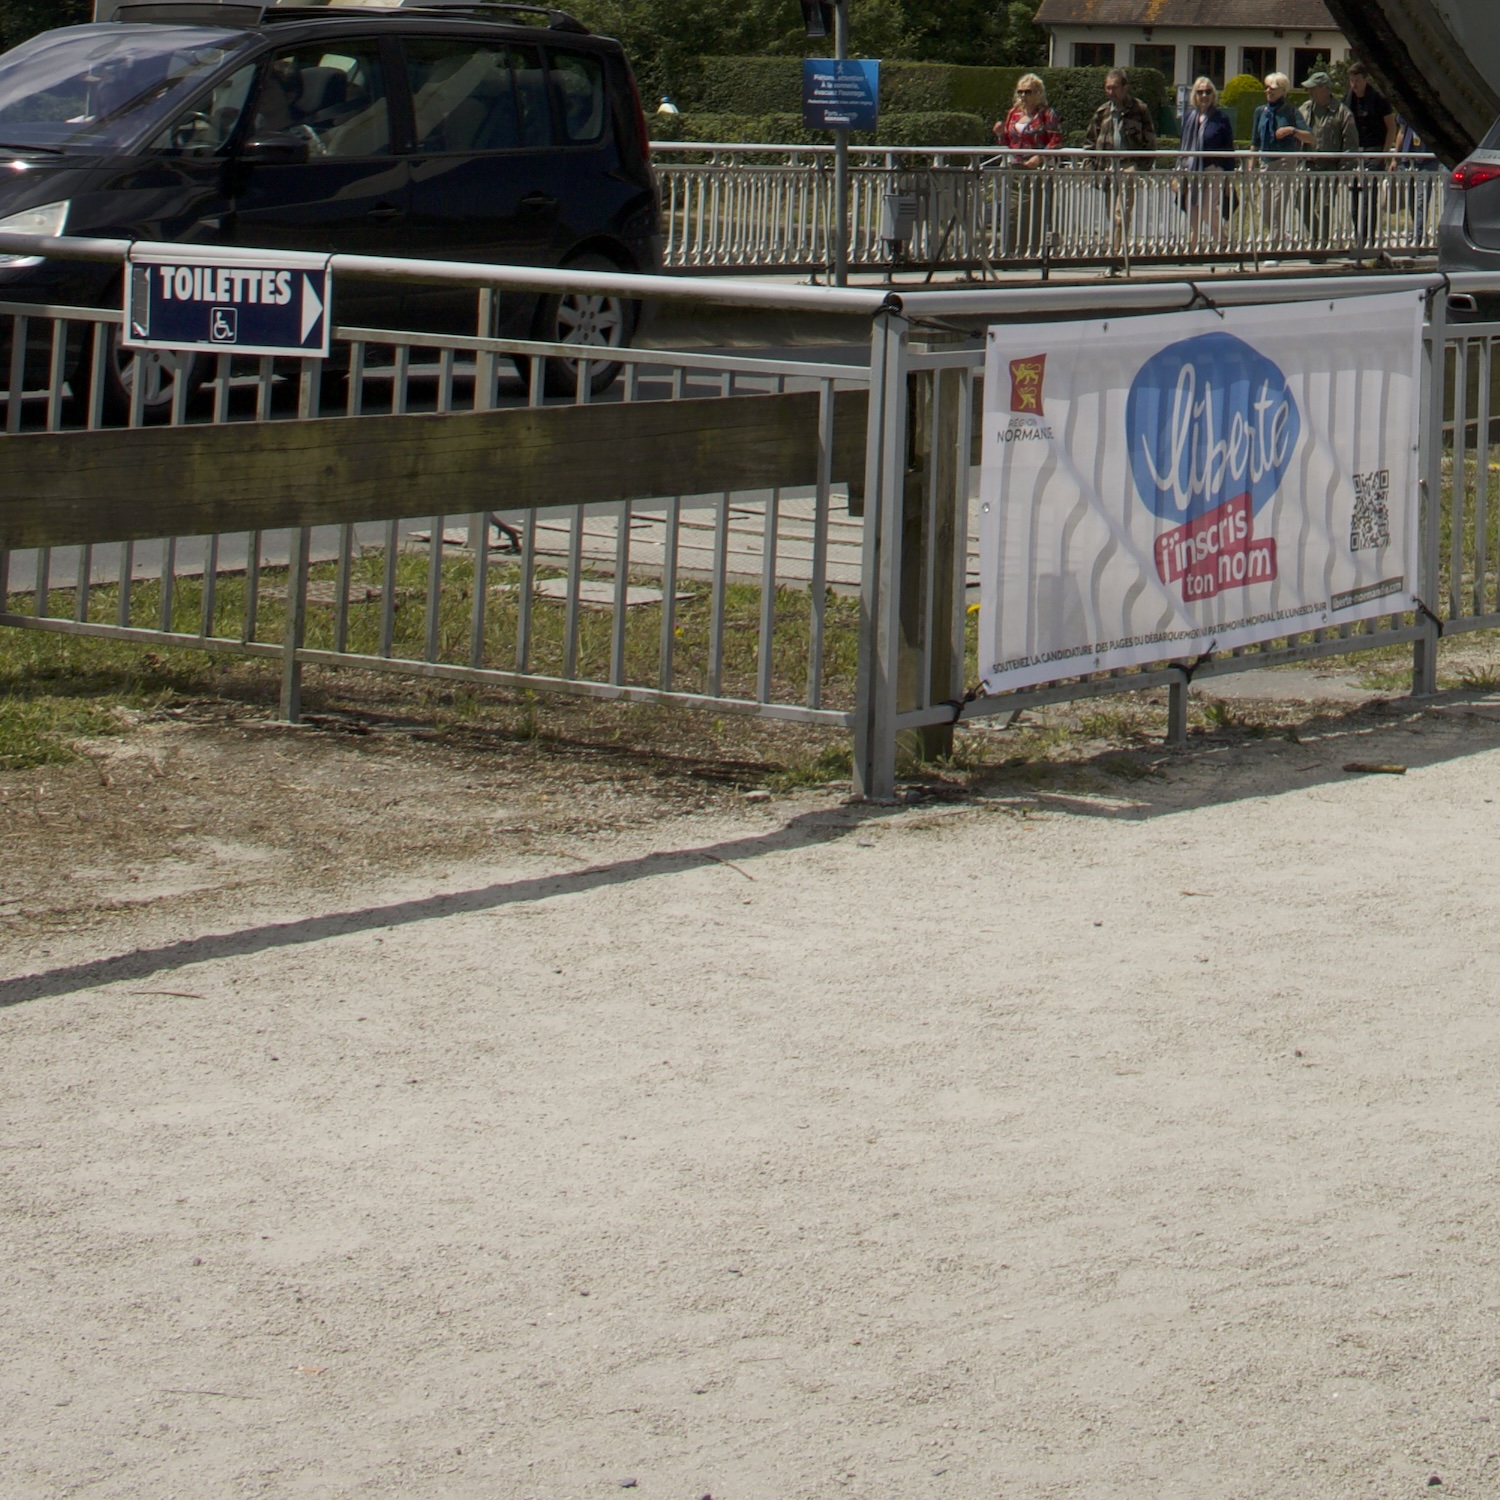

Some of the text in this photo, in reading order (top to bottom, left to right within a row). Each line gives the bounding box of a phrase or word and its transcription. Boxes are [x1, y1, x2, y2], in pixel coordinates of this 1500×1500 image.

[160, 266, 292, 306] TOILETTES
[1160, 503, 1248, 586] j'inscris
[1186, 546, 1272, 596] ton nom
[992, 656, 1031, 675] SOUTENEZ
[1030, 655, 1042, 666] LA
[1041, 644, 1094, 663] CANDIDATURE
[1095, 641, 1109, 654] DES
